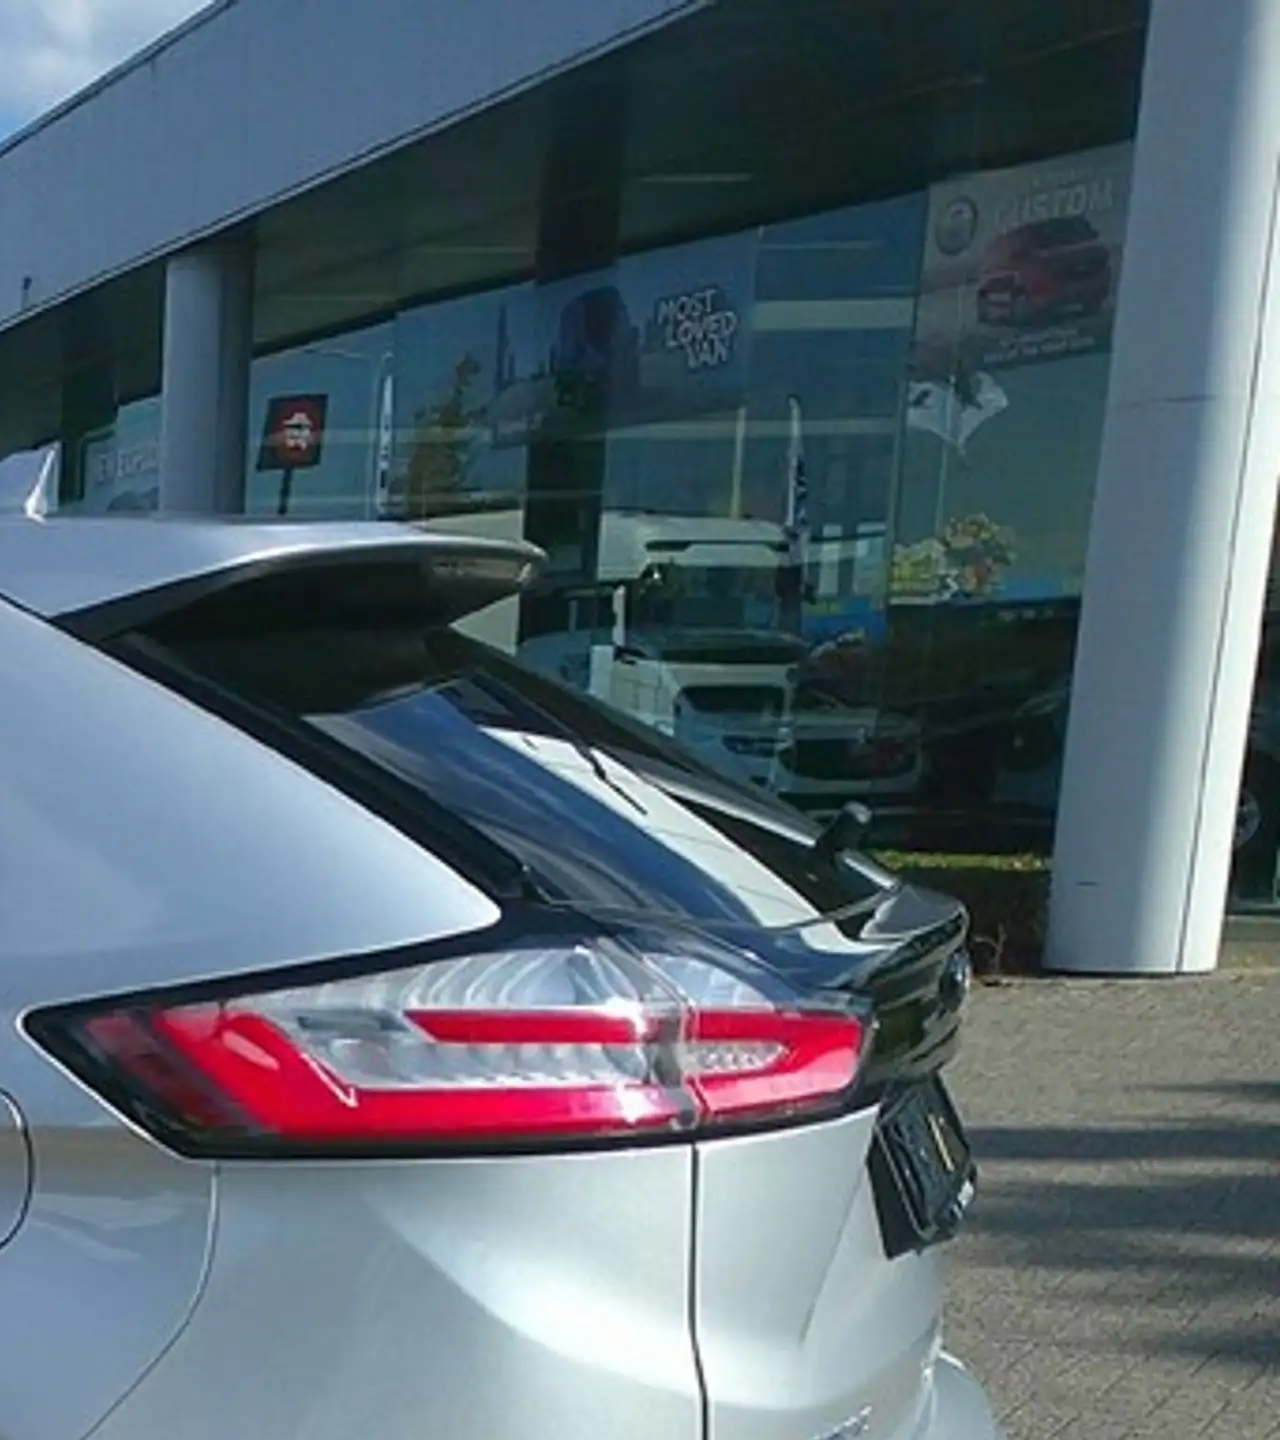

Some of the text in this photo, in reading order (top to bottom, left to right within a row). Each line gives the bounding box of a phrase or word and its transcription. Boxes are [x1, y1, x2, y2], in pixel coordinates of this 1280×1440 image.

[657, 290, 715, 325] MOST
[665, 310, 738, 347] LOVED
[684, 334, 729, 368] VAN
